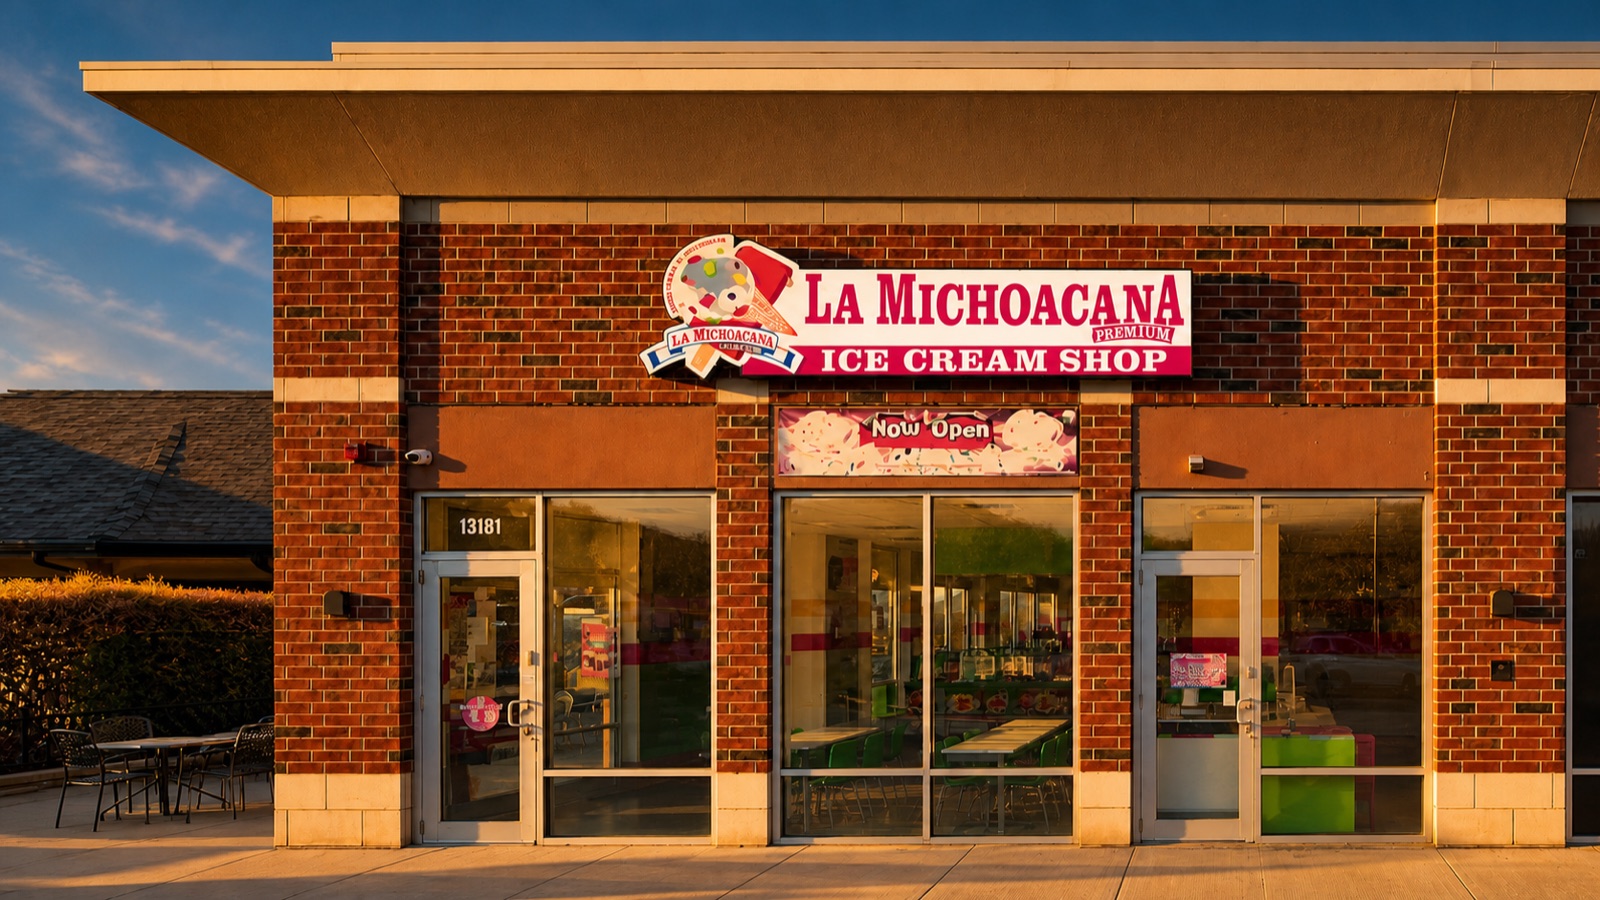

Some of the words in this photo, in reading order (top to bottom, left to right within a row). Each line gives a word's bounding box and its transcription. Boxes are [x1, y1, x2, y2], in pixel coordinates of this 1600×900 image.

[804, 273, 864, 325] LA
[876, 273, 1185, 327] MICHOACANA
[671, 332, 690, 347] LA
[693, 327, 774, 348] MICHOACANA
[1095, 325, 1170, 342] PREMIUM
[821, 348, 890, 373] ICE
[904, 348, 1048, 373] CREAM
[1059, 348, 1168, 373] SHOP
[872, 418, 921, 439] Now
[931, 419, 990, 441] Open
[460, 517, 501, 535] 13181
